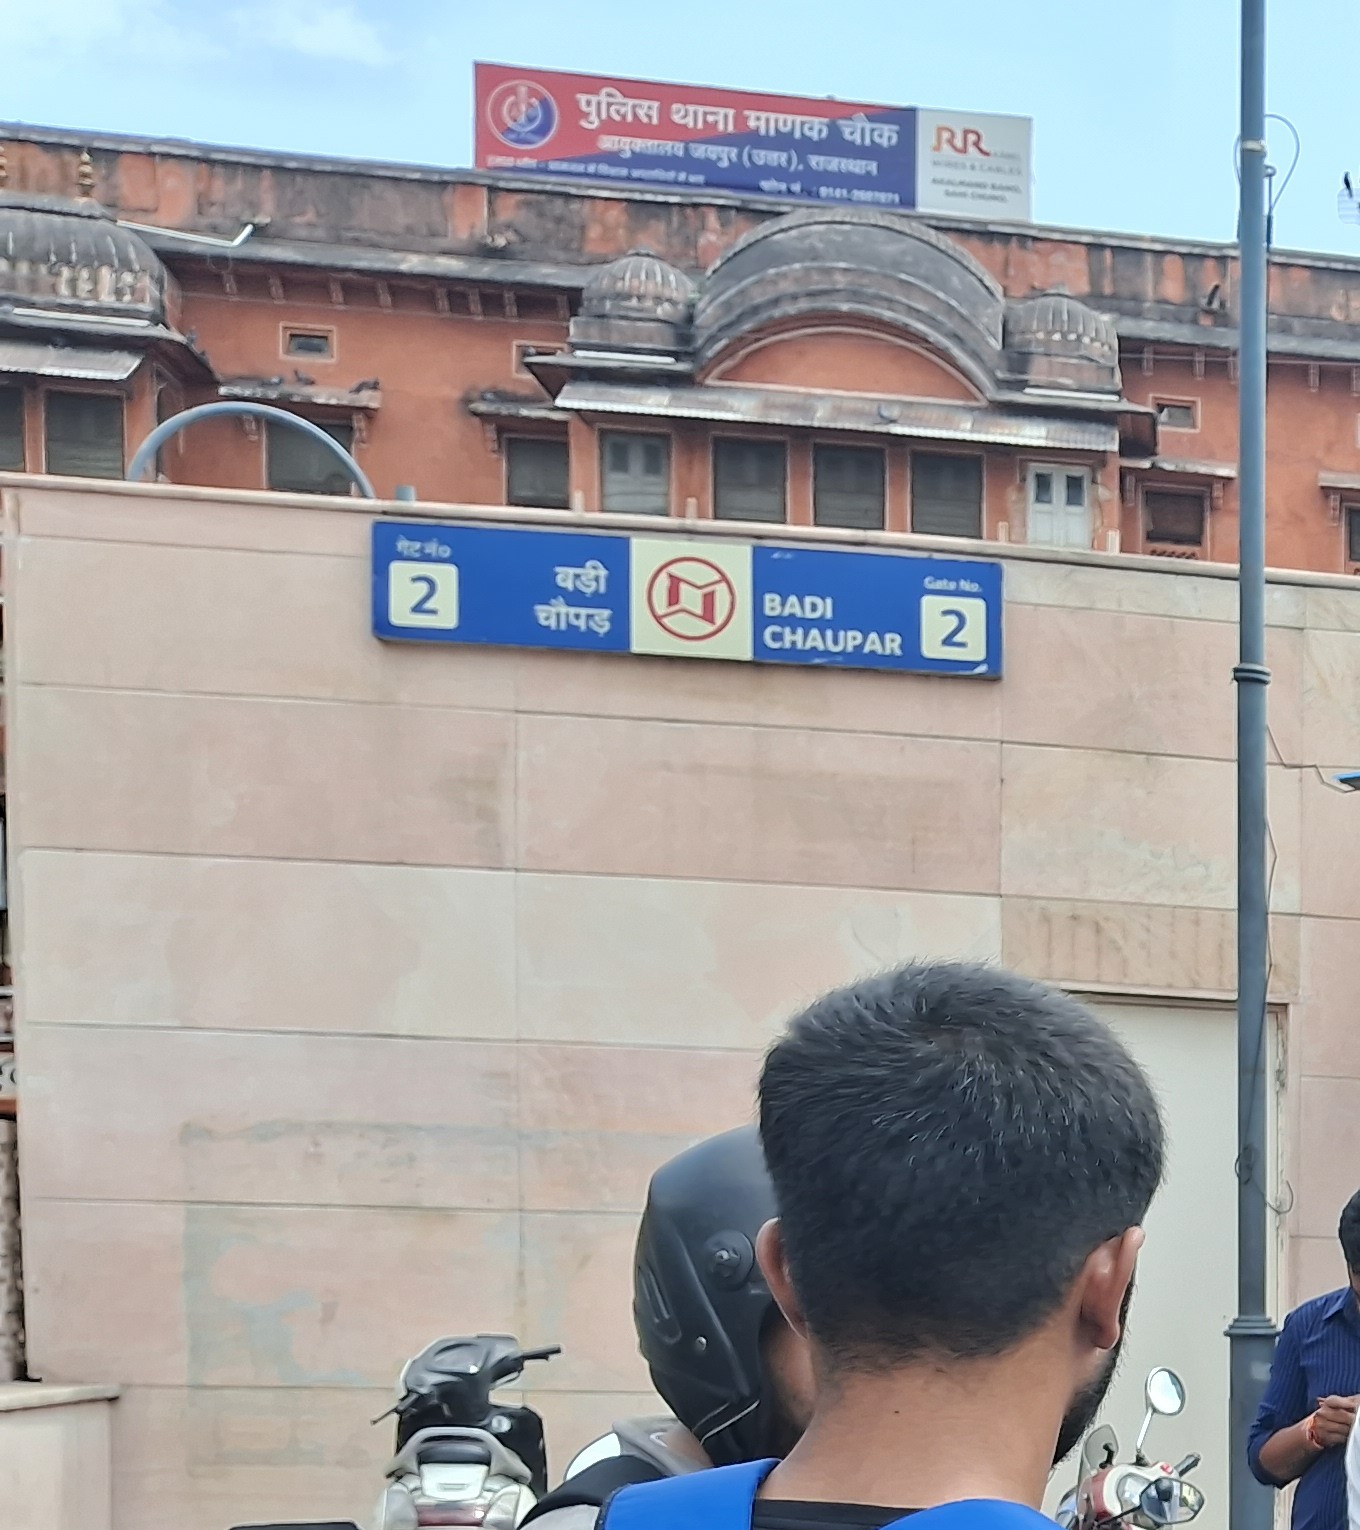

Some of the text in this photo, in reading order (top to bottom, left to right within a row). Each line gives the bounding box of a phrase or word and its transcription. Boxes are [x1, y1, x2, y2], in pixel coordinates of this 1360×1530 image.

[576, 87, 660, 129] पुलिस
[671, 100, 736, 133] थाना
[745, 109, 830, 141] माणक
[932, 124, 991, 157] RR
[808, 154, 878, 176] राजस्थान
[410, 574, 439, 616] 2
[923, 576, 982, 592] Gate No.
[534, 596, 613, 637] चौपड़
[763, 592, 833, 620] BADI
[763, 624, 903, 656] CHAUPAR
[940, 608, 968, 648] 2
